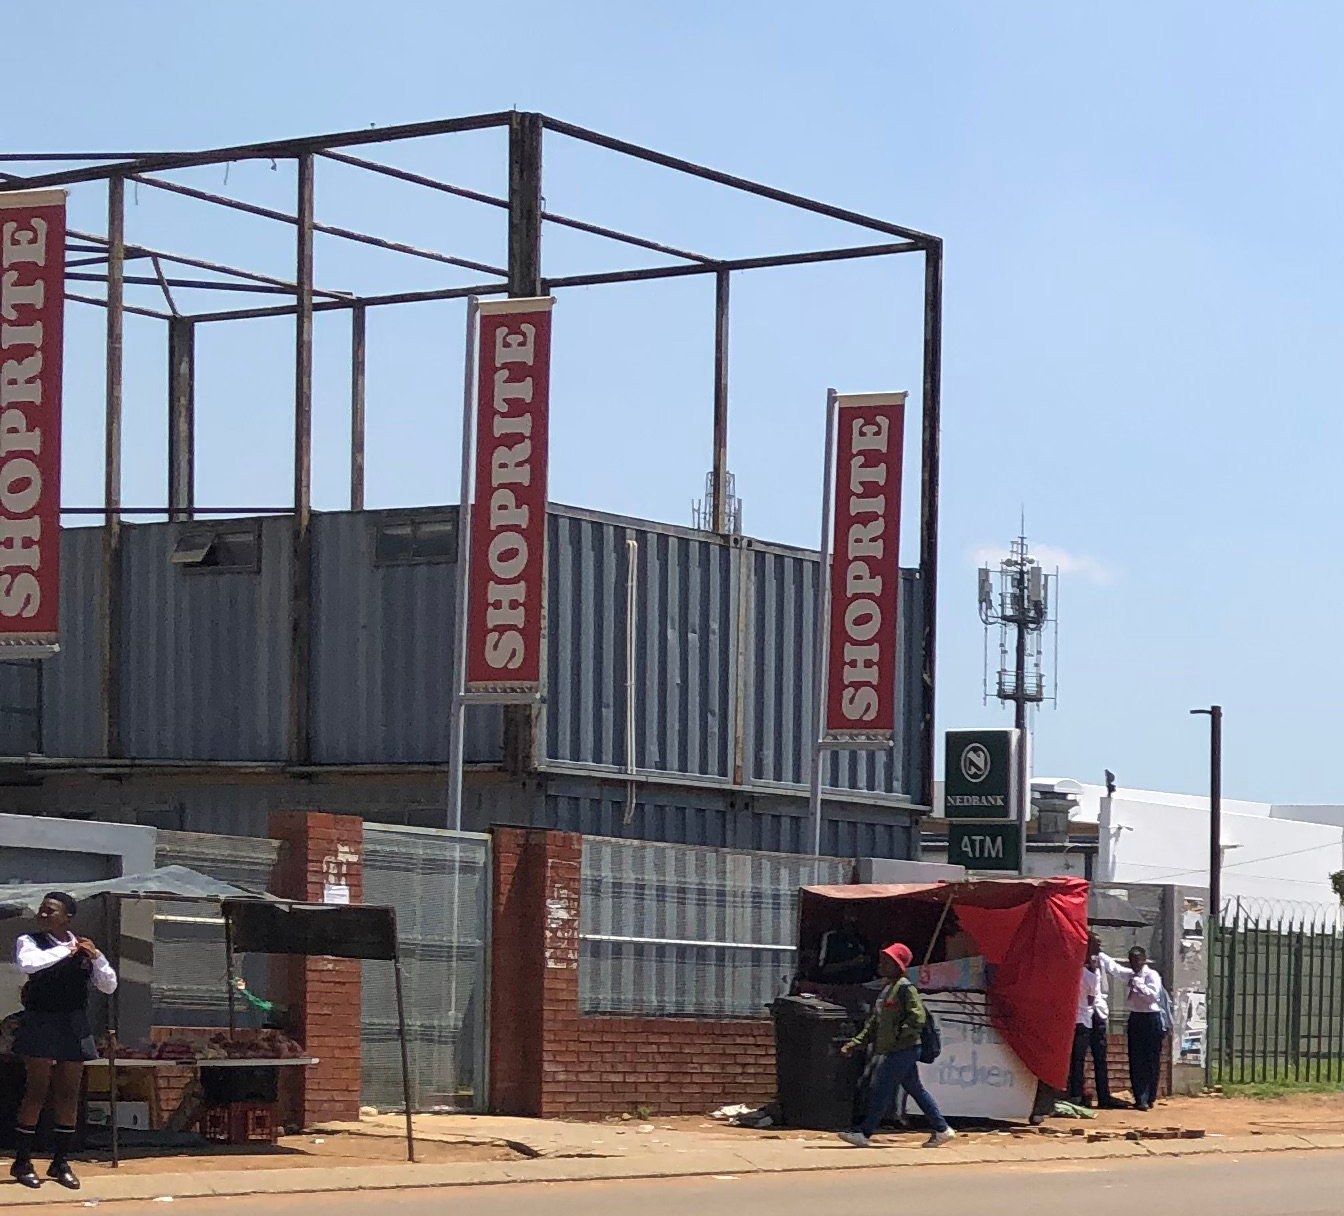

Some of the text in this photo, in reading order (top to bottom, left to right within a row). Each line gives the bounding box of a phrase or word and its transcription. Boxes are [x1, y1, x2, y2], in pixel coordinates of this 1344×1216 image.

[0, 217, 48, 618] SHOPRITE
[484, 323, 536, 669] SHOPRITE
[841, 415, 890, 721] SHOPRITE
[946, 795, 1004, 806] NEDBANK
[960, 835, 1003, 858] ATM
